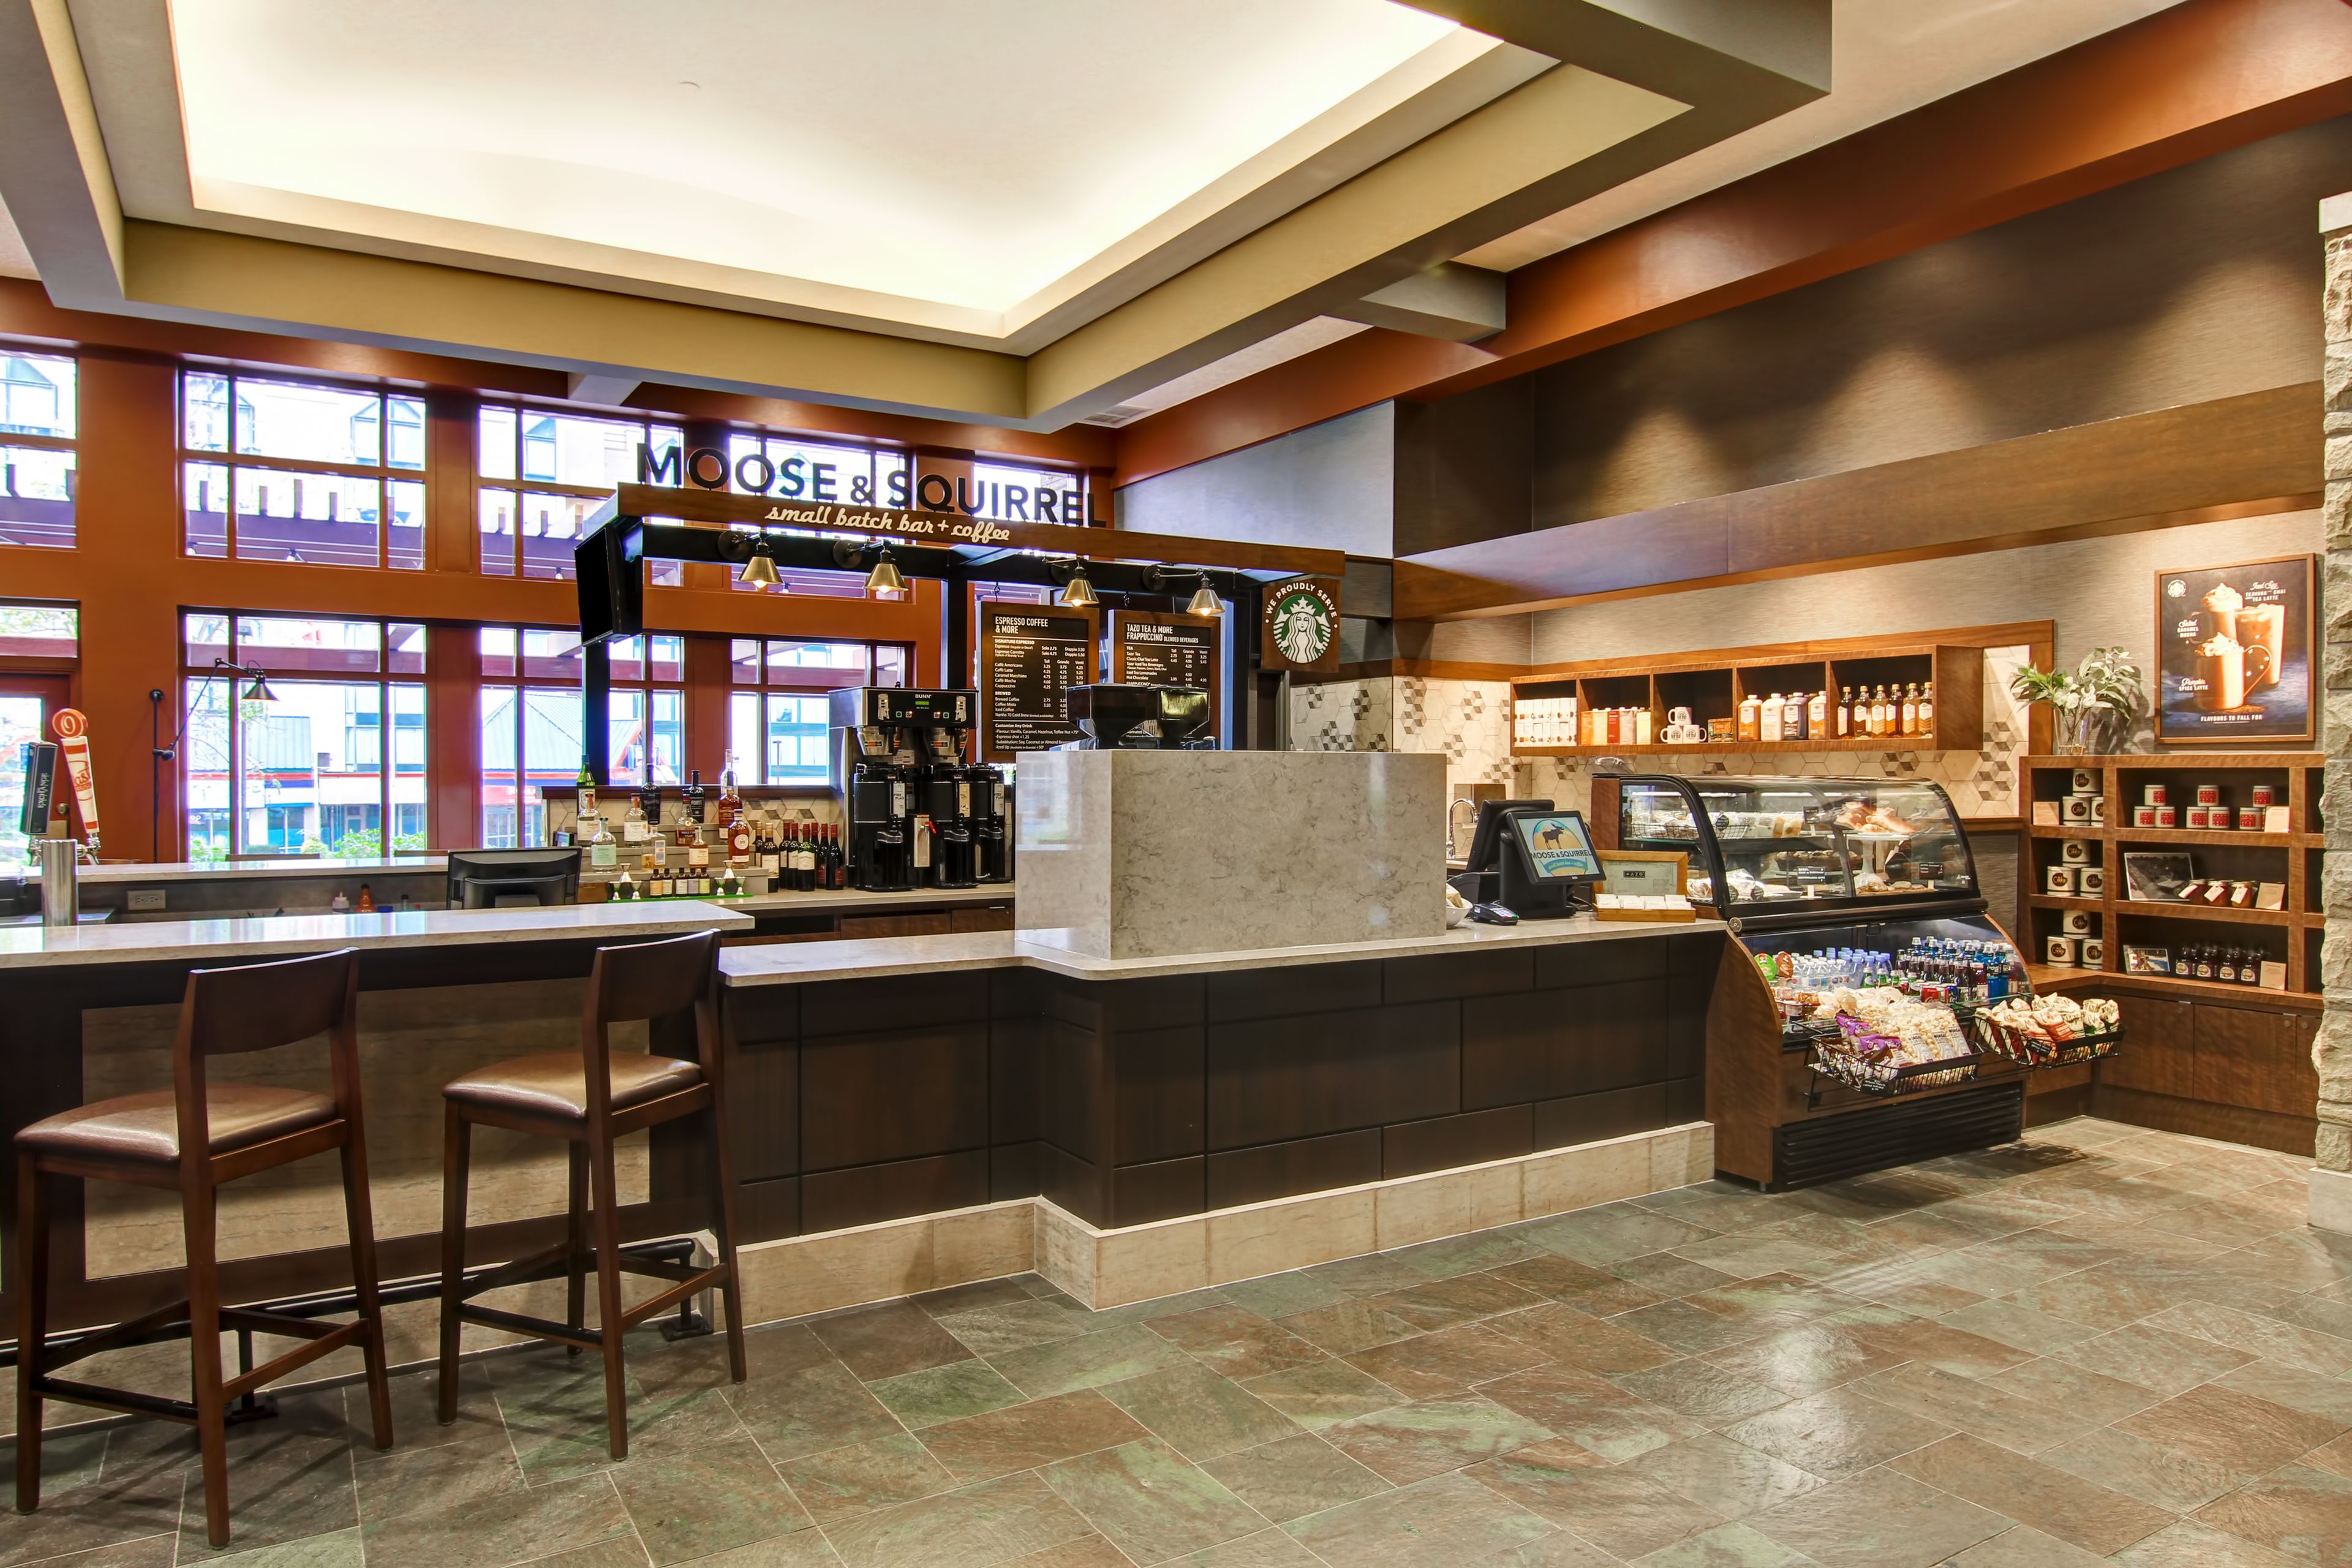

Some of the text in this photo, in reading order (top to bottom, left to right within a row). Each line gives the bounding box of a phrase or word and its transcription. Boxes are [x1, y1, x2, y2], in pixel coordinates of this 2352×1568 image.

[637, 442, 1106, 527] MOOSE & SQUIRREL
[765, 506, 1010, 544] small batch bar + coffee
[1266, 582, 1338, 618] WE PROUDLY SERVE
[995, 616, 1049, 627] ESPRESSO COFFEE
[995, 625, 1019, 634] & MORE
[1158, 625, 1174, 634] MORE
